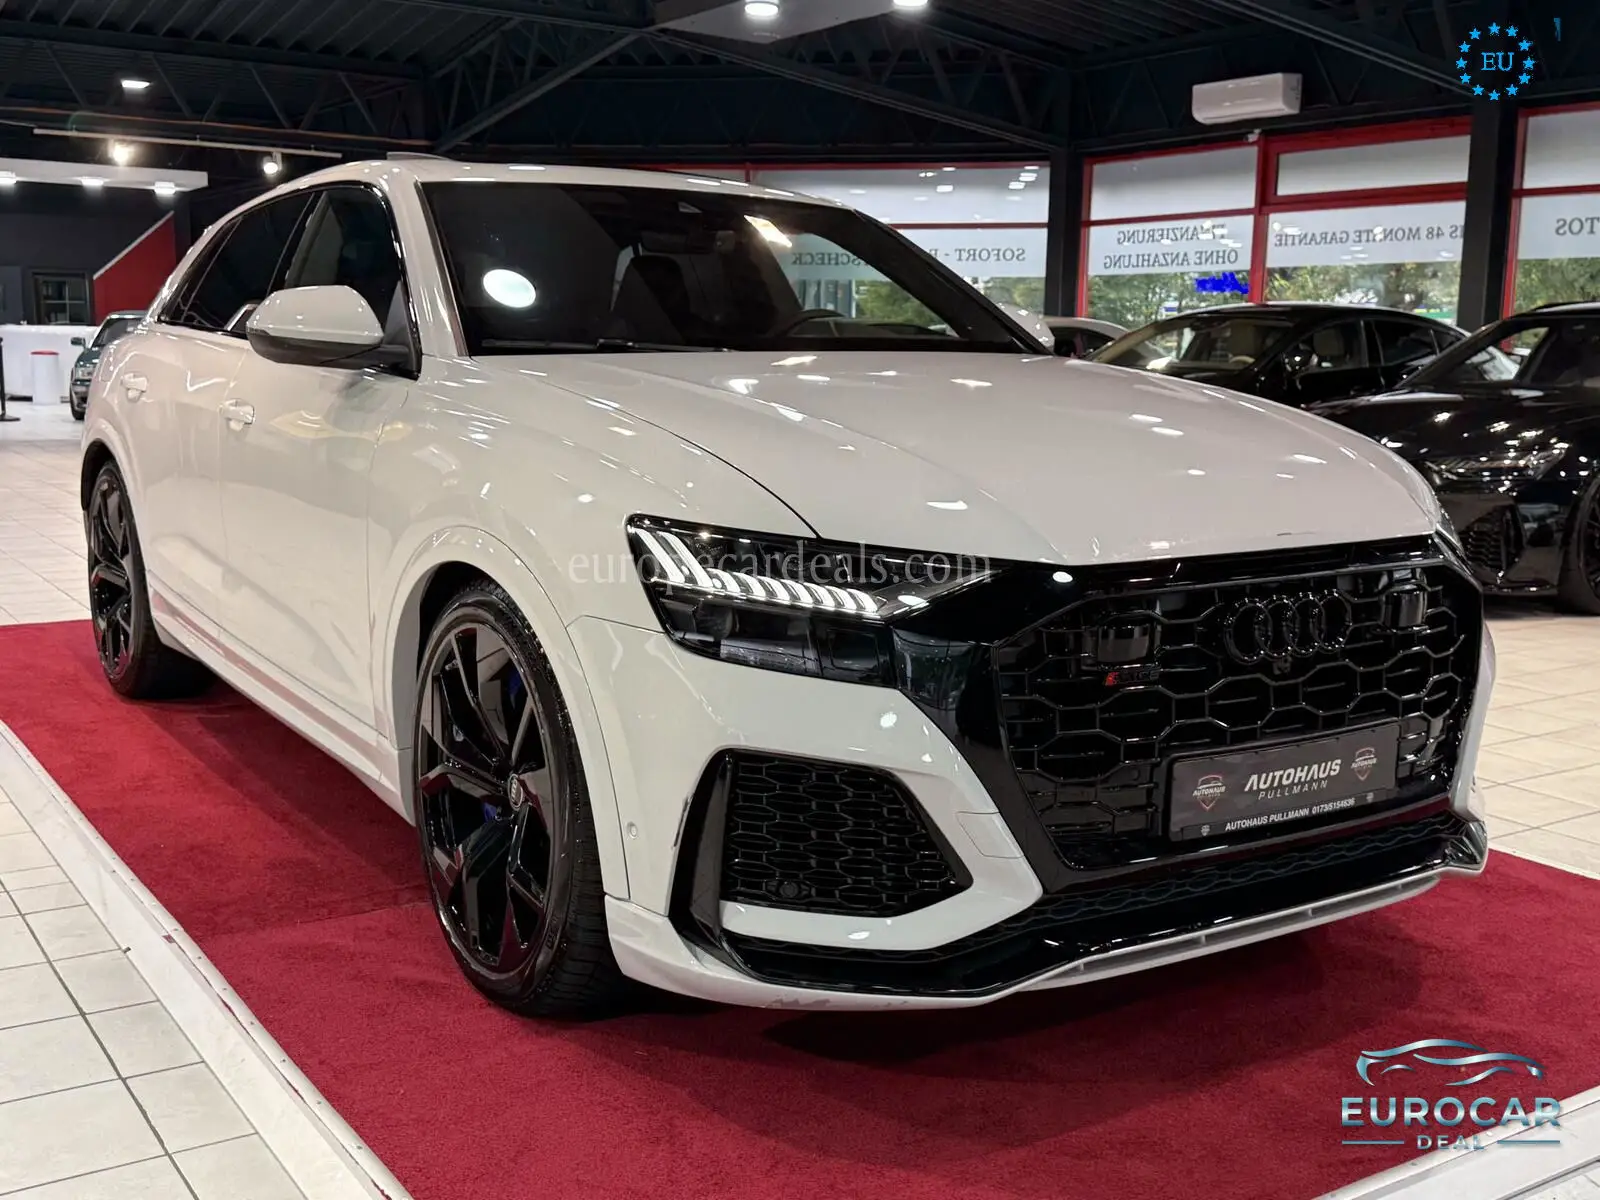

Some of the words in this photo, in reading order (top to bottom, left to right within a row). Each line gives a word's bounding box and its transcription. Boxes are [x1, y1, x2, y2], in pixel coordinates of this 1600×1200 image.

[1244, 758, 1342, 792] AUTOHAUS
[1258, 779, 1328, 800] PULLMANN
[1225, 815, 1268, 832] AUTOHAUS
[1269, 808, 1310, 823] PULLMANN
